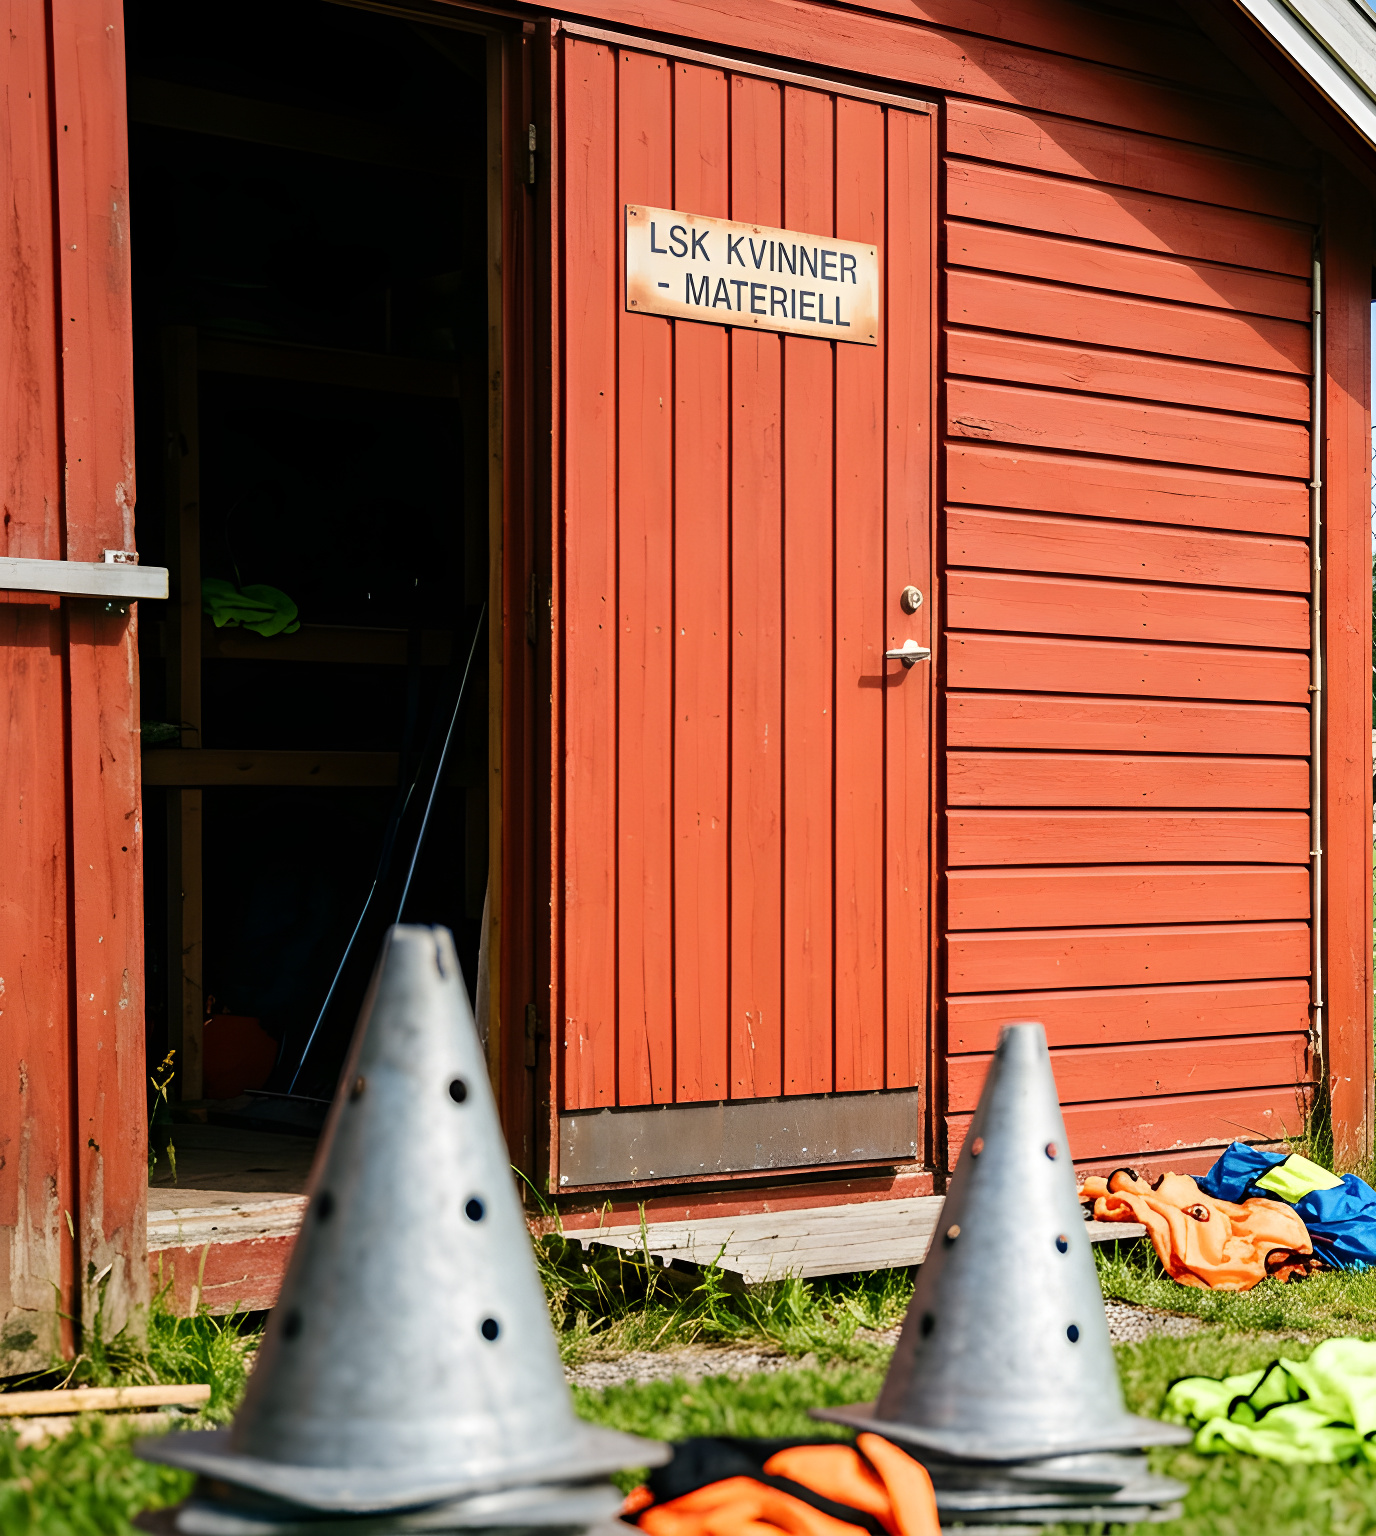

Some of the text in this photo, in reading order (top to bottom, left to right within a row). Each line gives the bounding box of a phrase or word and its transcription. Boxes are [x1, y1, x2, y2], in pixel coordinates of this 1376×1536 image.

[650, 221, 857, 285] LSK KVINNER
[685, 273, 851, 327] MATERIELL
